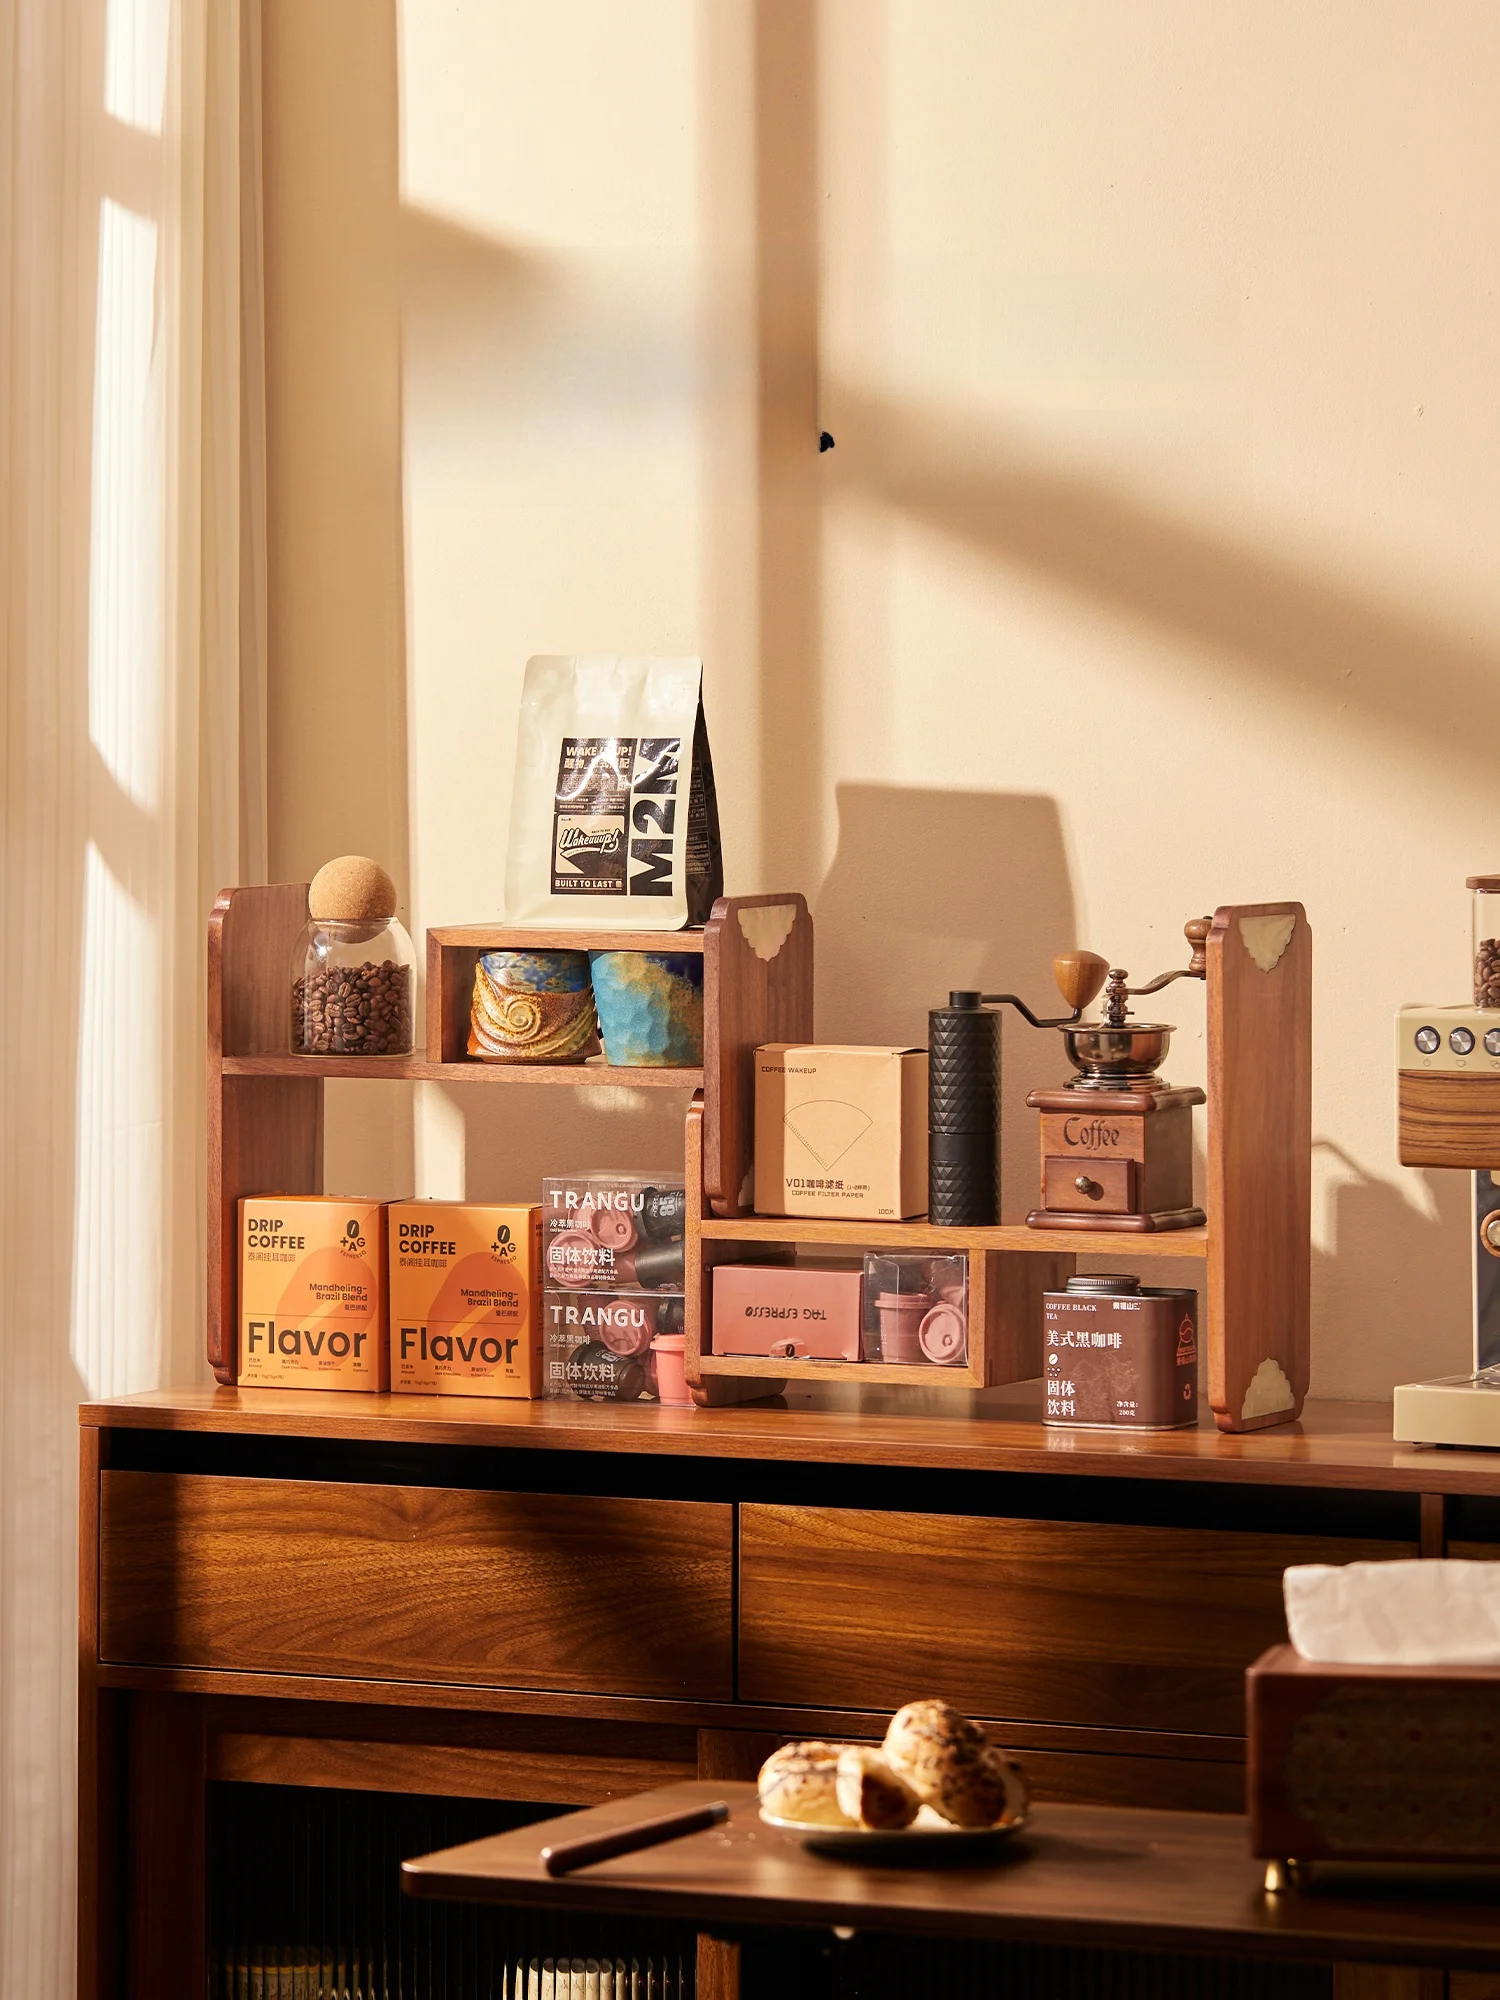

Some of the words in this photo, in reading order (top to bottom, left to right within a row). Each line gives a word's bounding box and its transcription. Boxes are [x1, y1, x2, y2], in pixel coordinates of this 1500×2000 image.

[566, 746, 597, 756] WAKE
[630, 738, 681, 896] M2M
[555, 880, 578, 888] BUILT
[580, 880, 591, 888] TO
[593, 880, 613, 888] LAST
[1063, 1117, 1120, 1150] Coffee
[549, 1190, 645, 1212] TRANGU
[248, 1218, 284, 1232] DRIP
[399, 1224, 435, 1238] DRIP
[247, 1235, 306, 1250] COFFEE
[399, 1240, 456, 1255] COFFEE
[340, 1249, 367, 1260] ESPRESSO
[490, 1254, 517, 1264] ESPRESSO
[549, 1246, 616, 1267] 固体饮料
[309, 1283, 367, 1294] Mandheling-
[460, 1288, 518, 1300] Mandheling-
[316, 1292, 341, 1301] Brazil
[342, 1292, 368, 1302] Blend
[467, 1298, 492, 1306] Brazil
[493, 1298, 519, 1307] Blend
[745, 1306, 798, 1319] ESPRESSO
[803, 1308, 827, 1320] TAG
[1045, 1302, 1071, 1311] COFFEE
[1072, 1303, 1097, 1312] BLACK
[549, 1305, 645, 1327] TRANGU
[1045, 1312, 1058, 1320] TEA
[248, 1321, 367, 1358] Flavor
[400, 1327, 519, 1364] Flavor
[549, 1333, 591, 1345] 冷萃黑咖啡
[1046, 1329, 1123, 1349] 美式黑咖啡
[549, 1361, 616, 1382] 固体饮料
[1047, 1379, 1076, 1397] 固体
[1047, 1398, 1076, 1417] 饮料
